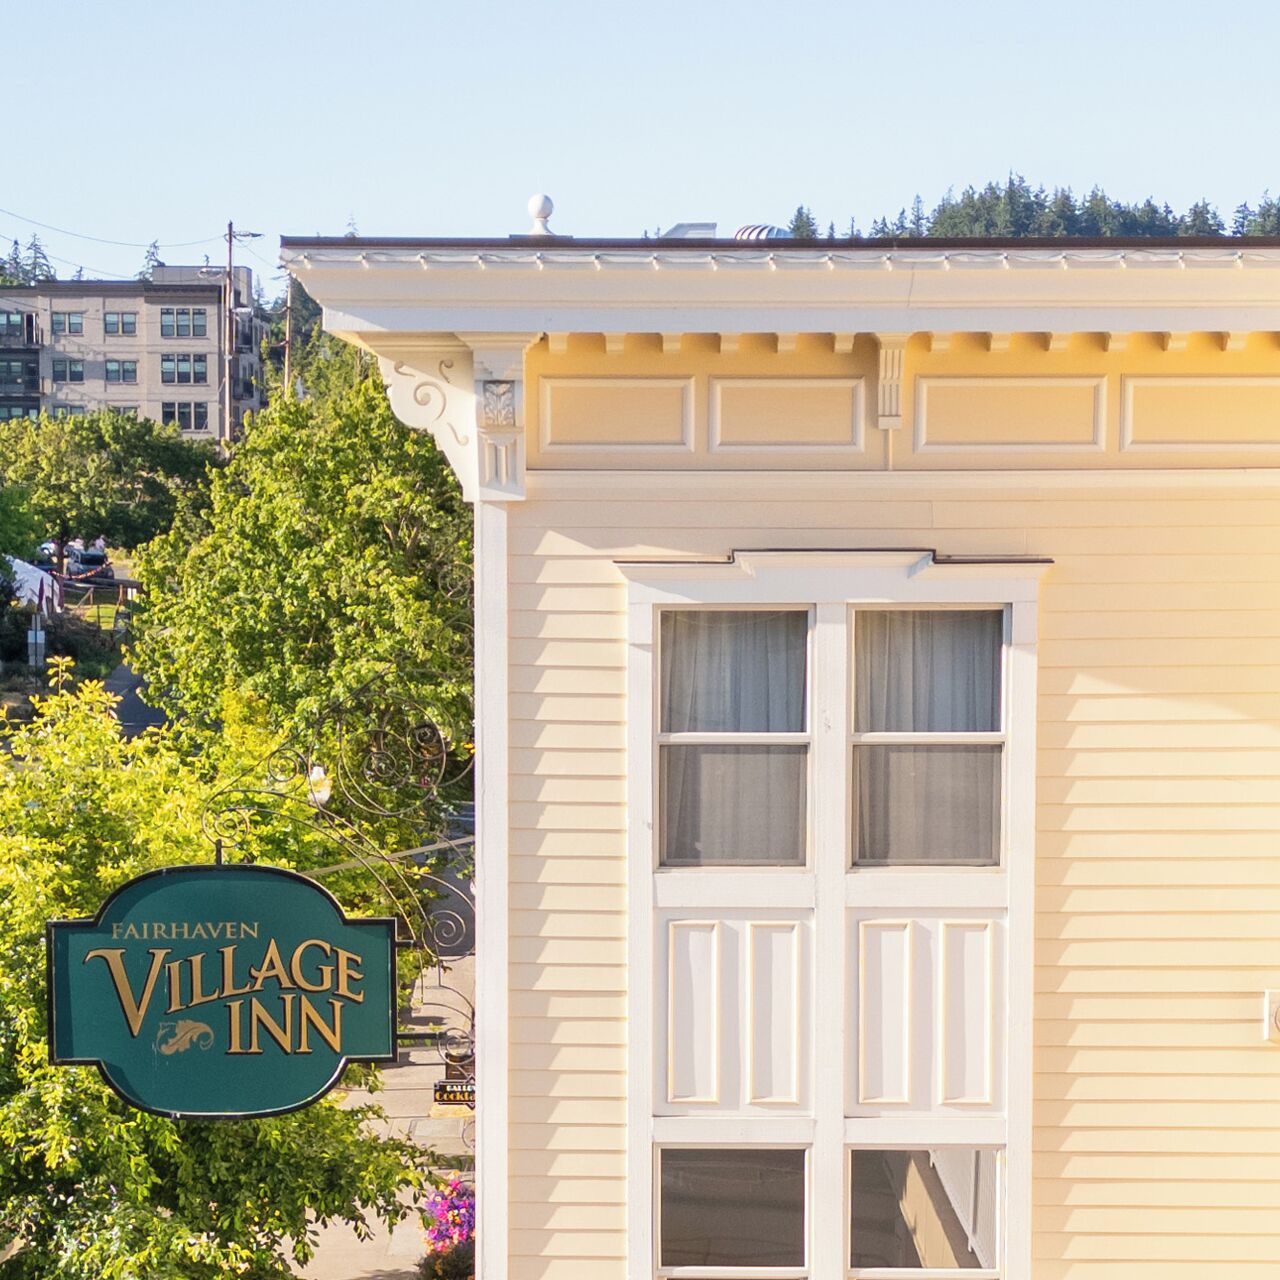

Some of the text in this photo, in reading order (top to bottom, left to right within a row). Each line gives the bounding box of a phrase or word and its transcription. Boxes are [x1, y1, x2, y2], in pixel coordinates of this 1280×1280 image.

[111, 921, 259, 939] FAIRHAVEN
[83, 937, 365, 1038] VILLAGE
[225, 993, 344, 1054] INN
